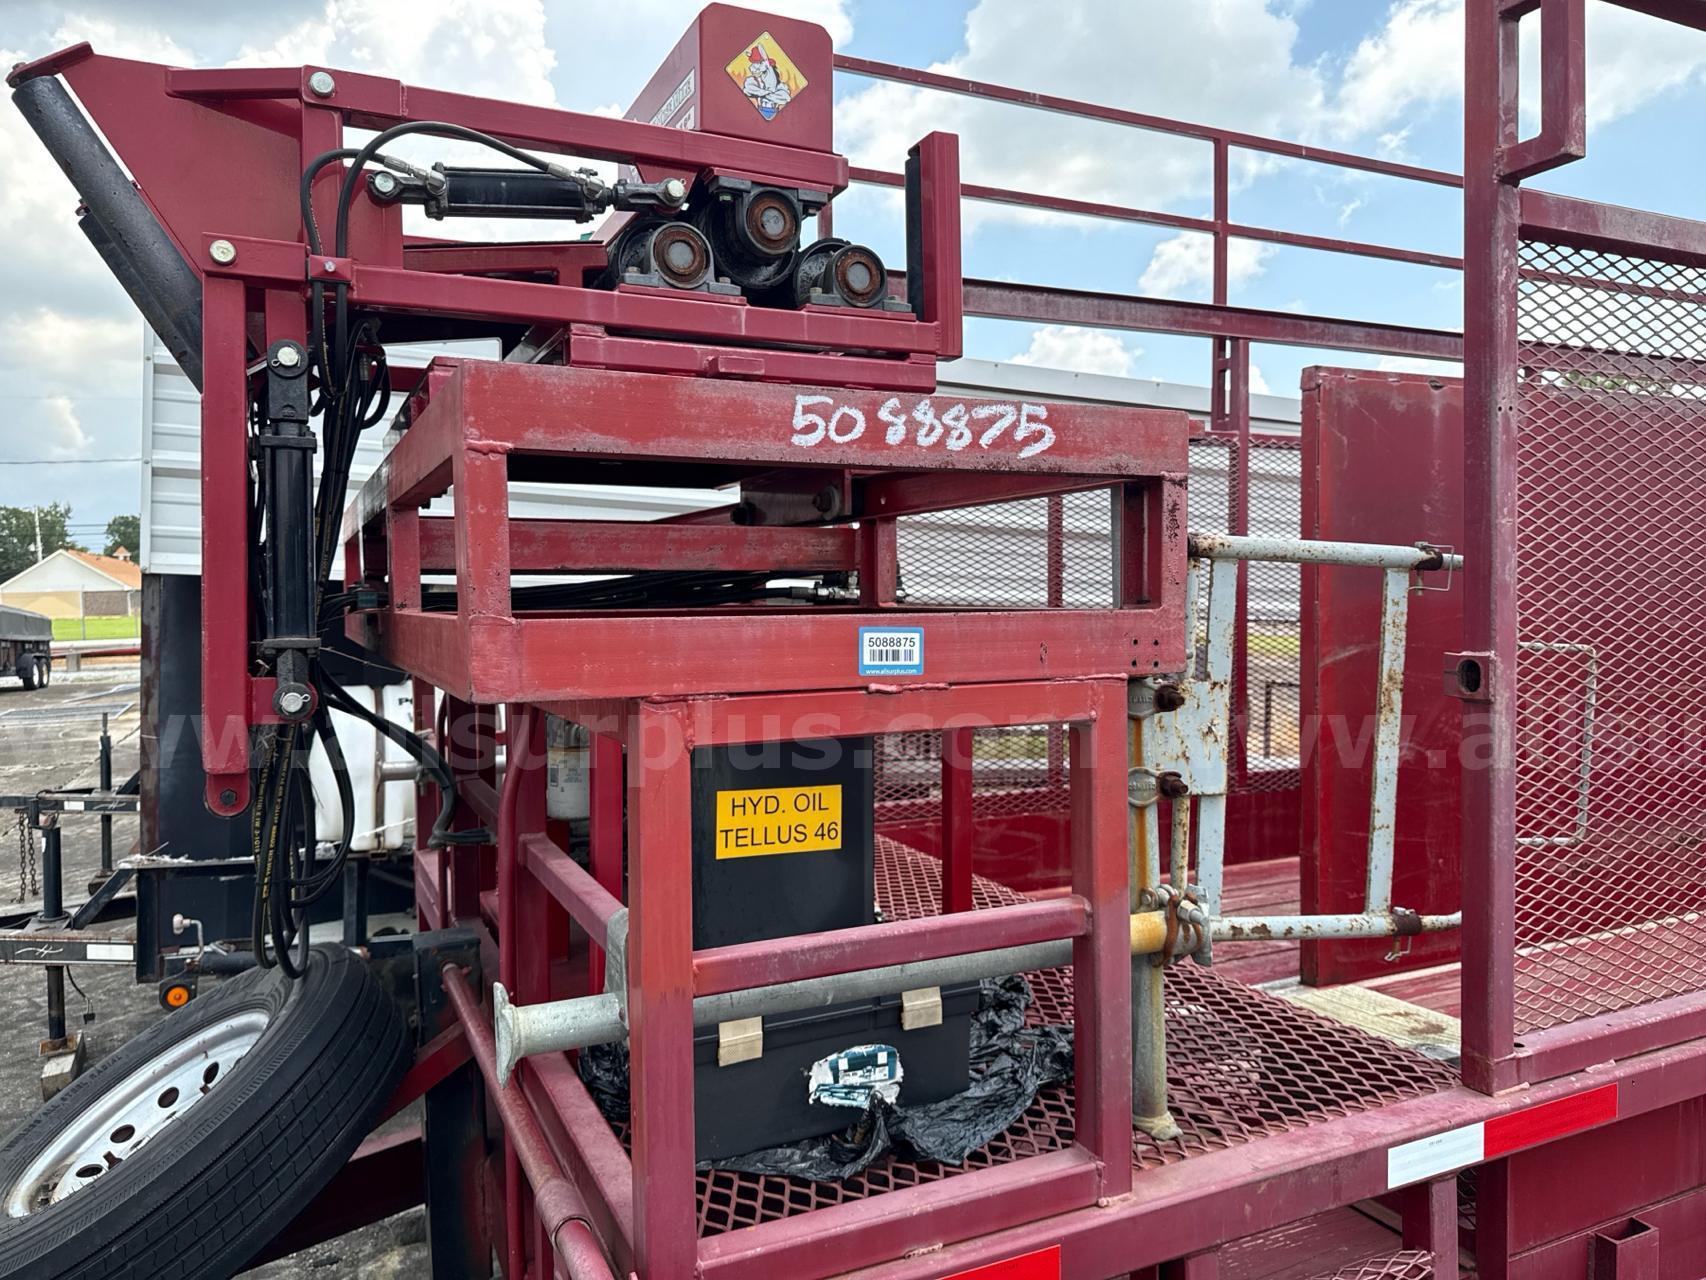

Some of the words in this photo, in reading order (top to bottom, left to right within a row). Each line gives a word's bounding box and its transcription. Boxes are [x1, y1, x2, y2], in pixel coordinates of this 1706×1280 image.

[868, 636, 916, 648] 5088875
[731, 795, 785, 816] HYD.
[794, 792, 829, 812] OIL
[720, 824, 808, 848] TELLUS
[814, 822, 839, 840] 46
